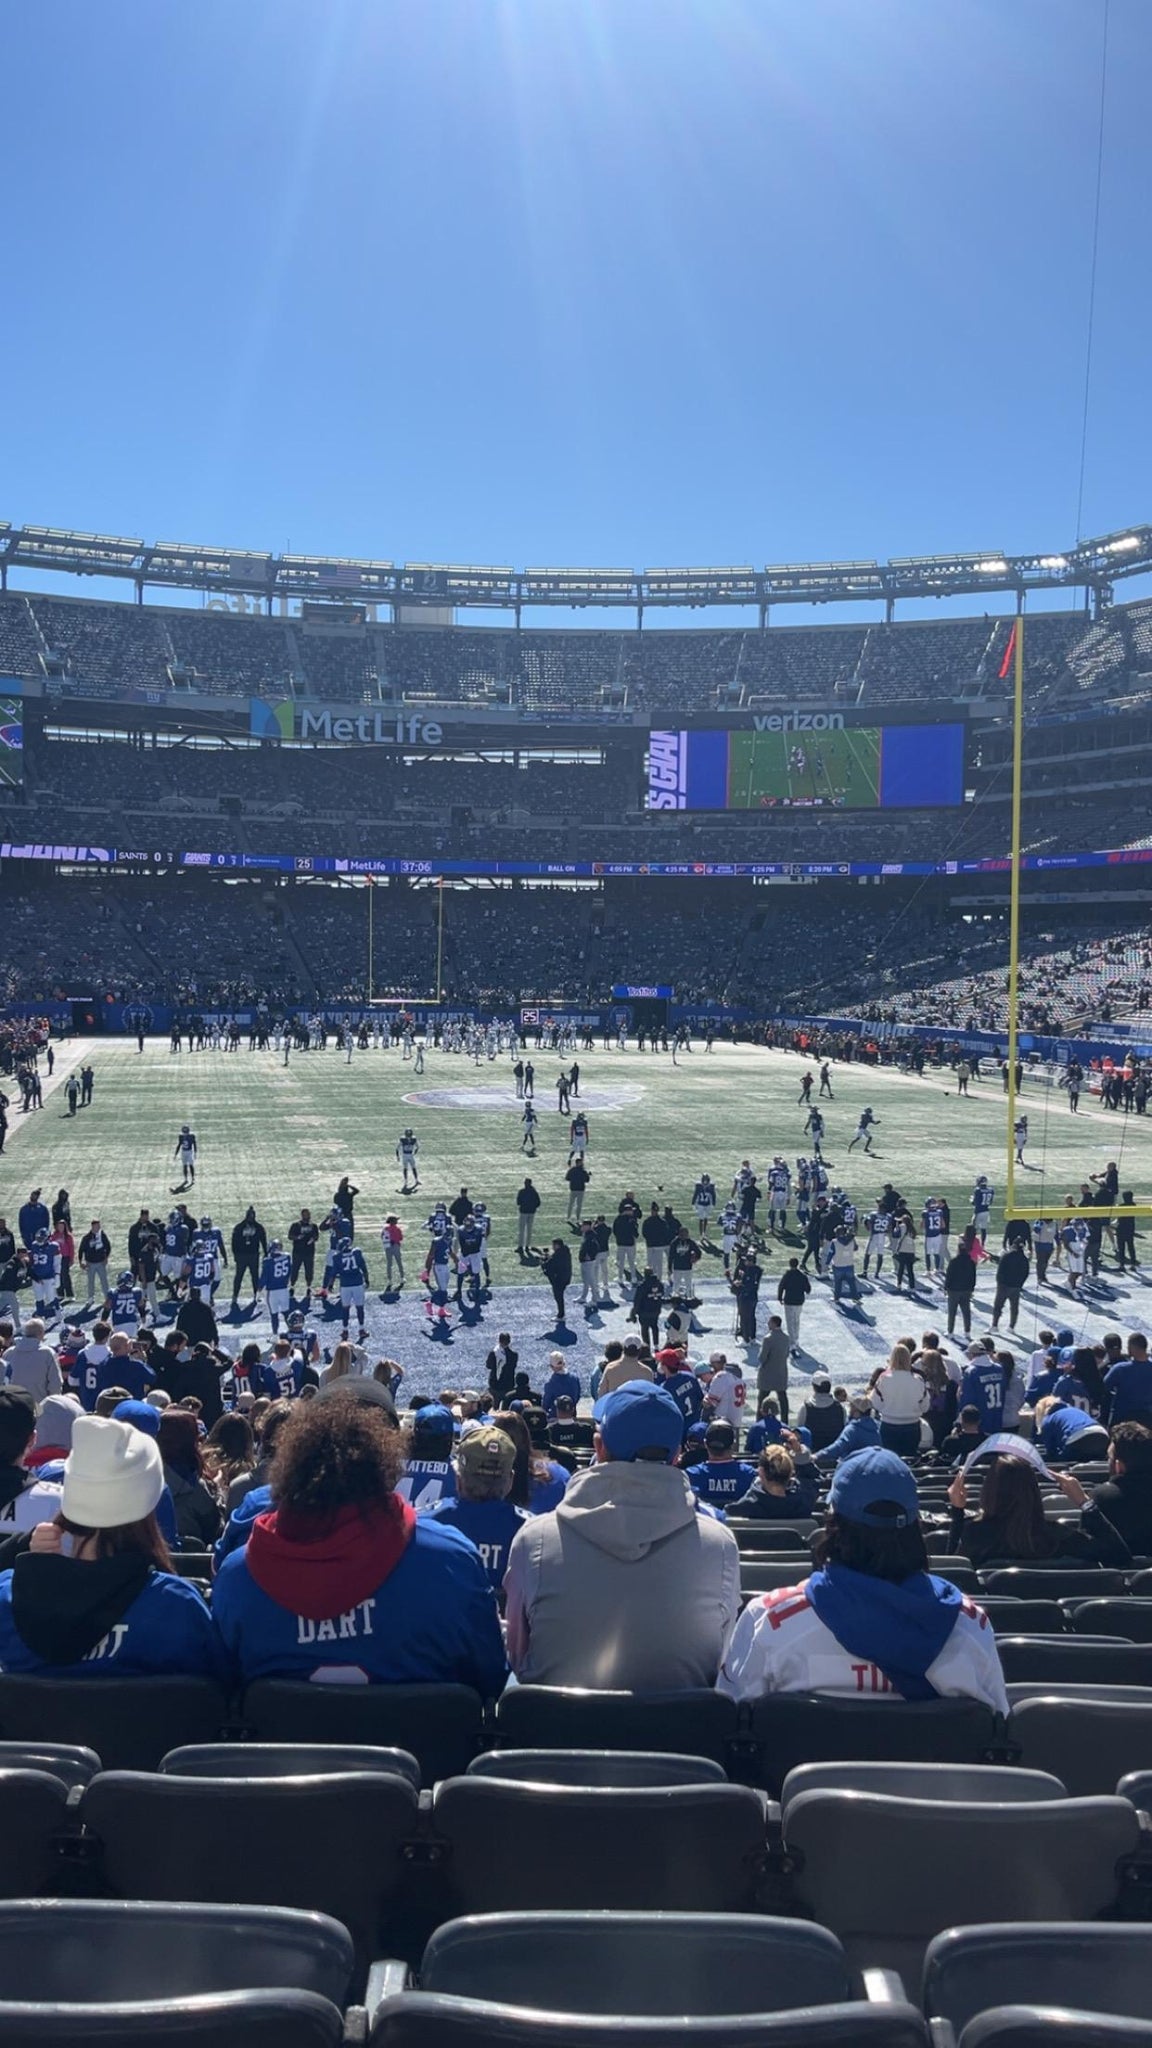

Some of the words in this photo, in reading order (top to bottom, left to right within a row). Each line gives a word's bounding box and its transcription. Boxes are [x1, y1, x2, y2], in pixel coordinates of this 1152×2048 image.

[302, 709, 443, 744] MetLife
[753, 710, 844, 732] verizon
[118, 852, 148, 860] SAINTS
[154, 852, 161, 861] 0
[218, 855, 225, 864] 0
[297, 859, 310, 869] 25
[350, 861, 386, 871] MetLife
[402, 862, 431, 872] 37:06
[523, 1011, 537, 1021] 25
[928, 1216, 941, 1229] 13
[195, 1262, 211, 1278] 60
[274, 1260, 289, 1278] 65
[342, 1256, 357, 1270] 71
[115, 1299, 136, 1314] 76
[86, 1368, 97, 1389] 6
[279, 1377, 297, 1396] 51
[985, 1383, 1002, 1409] 31
[685, 1396, 693, 1417] 1
[402, 1460, 449, 1475] KATTEBO
[708, 1478, 737, 1491] DART
[479, 1543, 502, 1569] RT
[297, 1598, 376, 1644] DART
